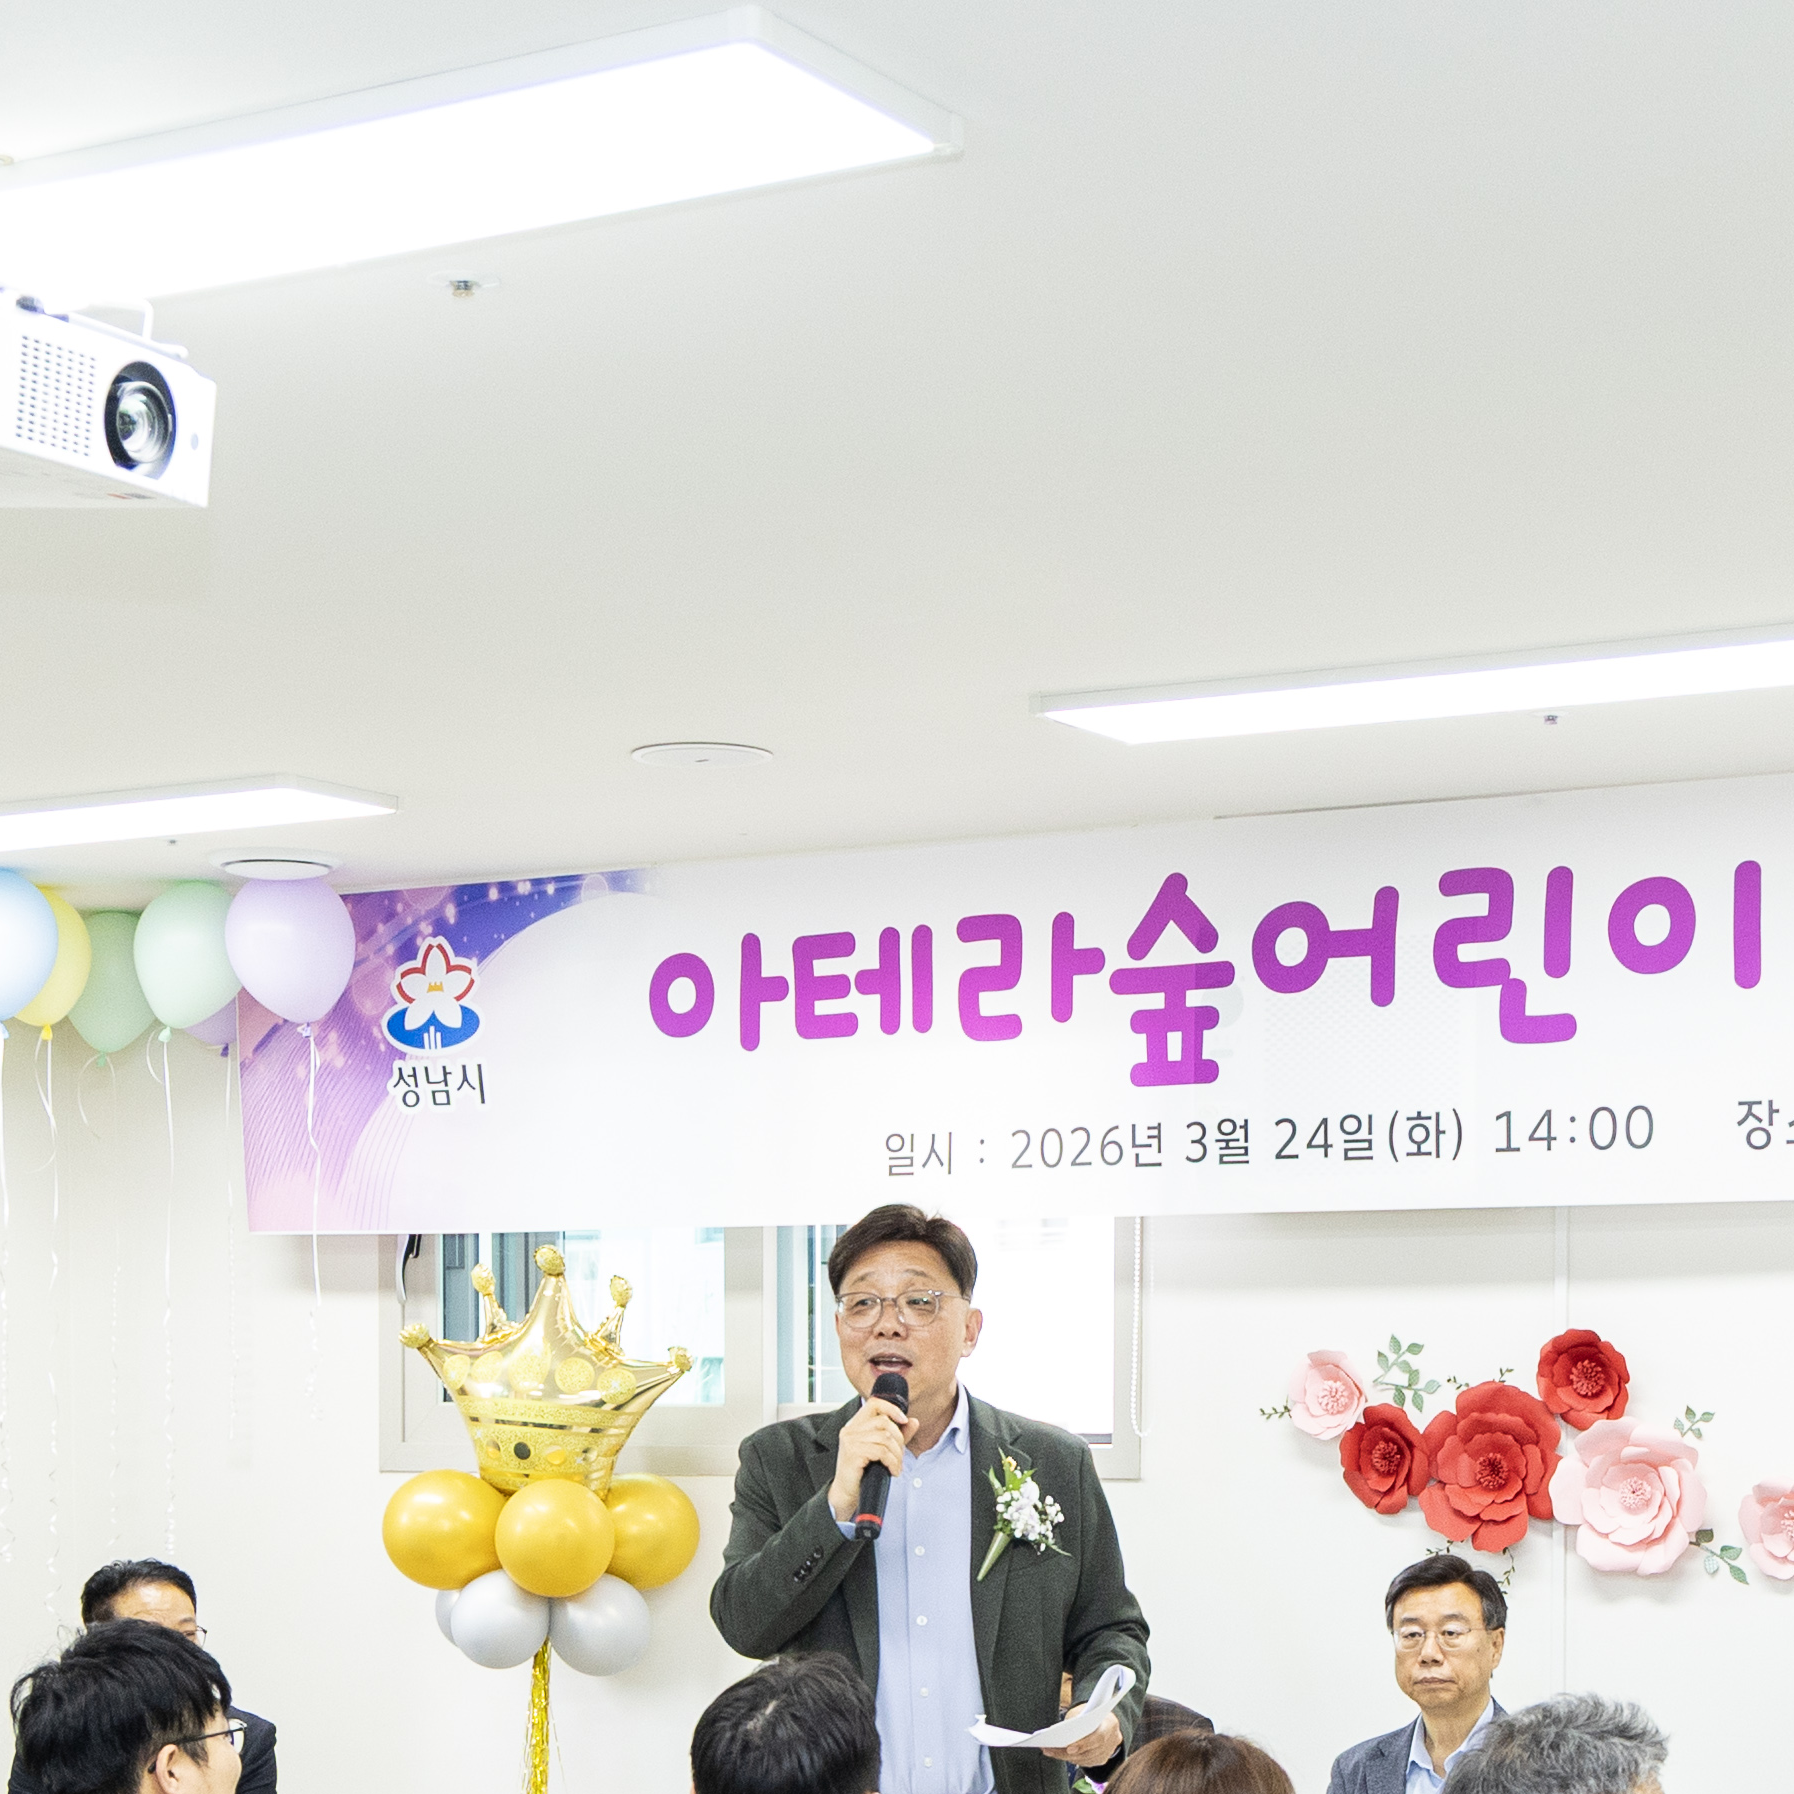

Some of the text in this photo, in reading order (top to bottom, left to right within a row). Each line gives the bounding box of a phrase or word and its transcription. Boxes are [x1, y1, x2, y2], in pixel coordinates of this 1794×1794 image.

[392, 1062, 487, 1109] 성남시
[885, 1131, 954, 1177] 일시
[1010, 1121, 1164, 1169] 2026년
[1183, 1117, 1251, 1166] 3월
[1273, 1107, 1464, 1164] 24일(화)
[1494, 1103, 1656, 1154] 14:00
